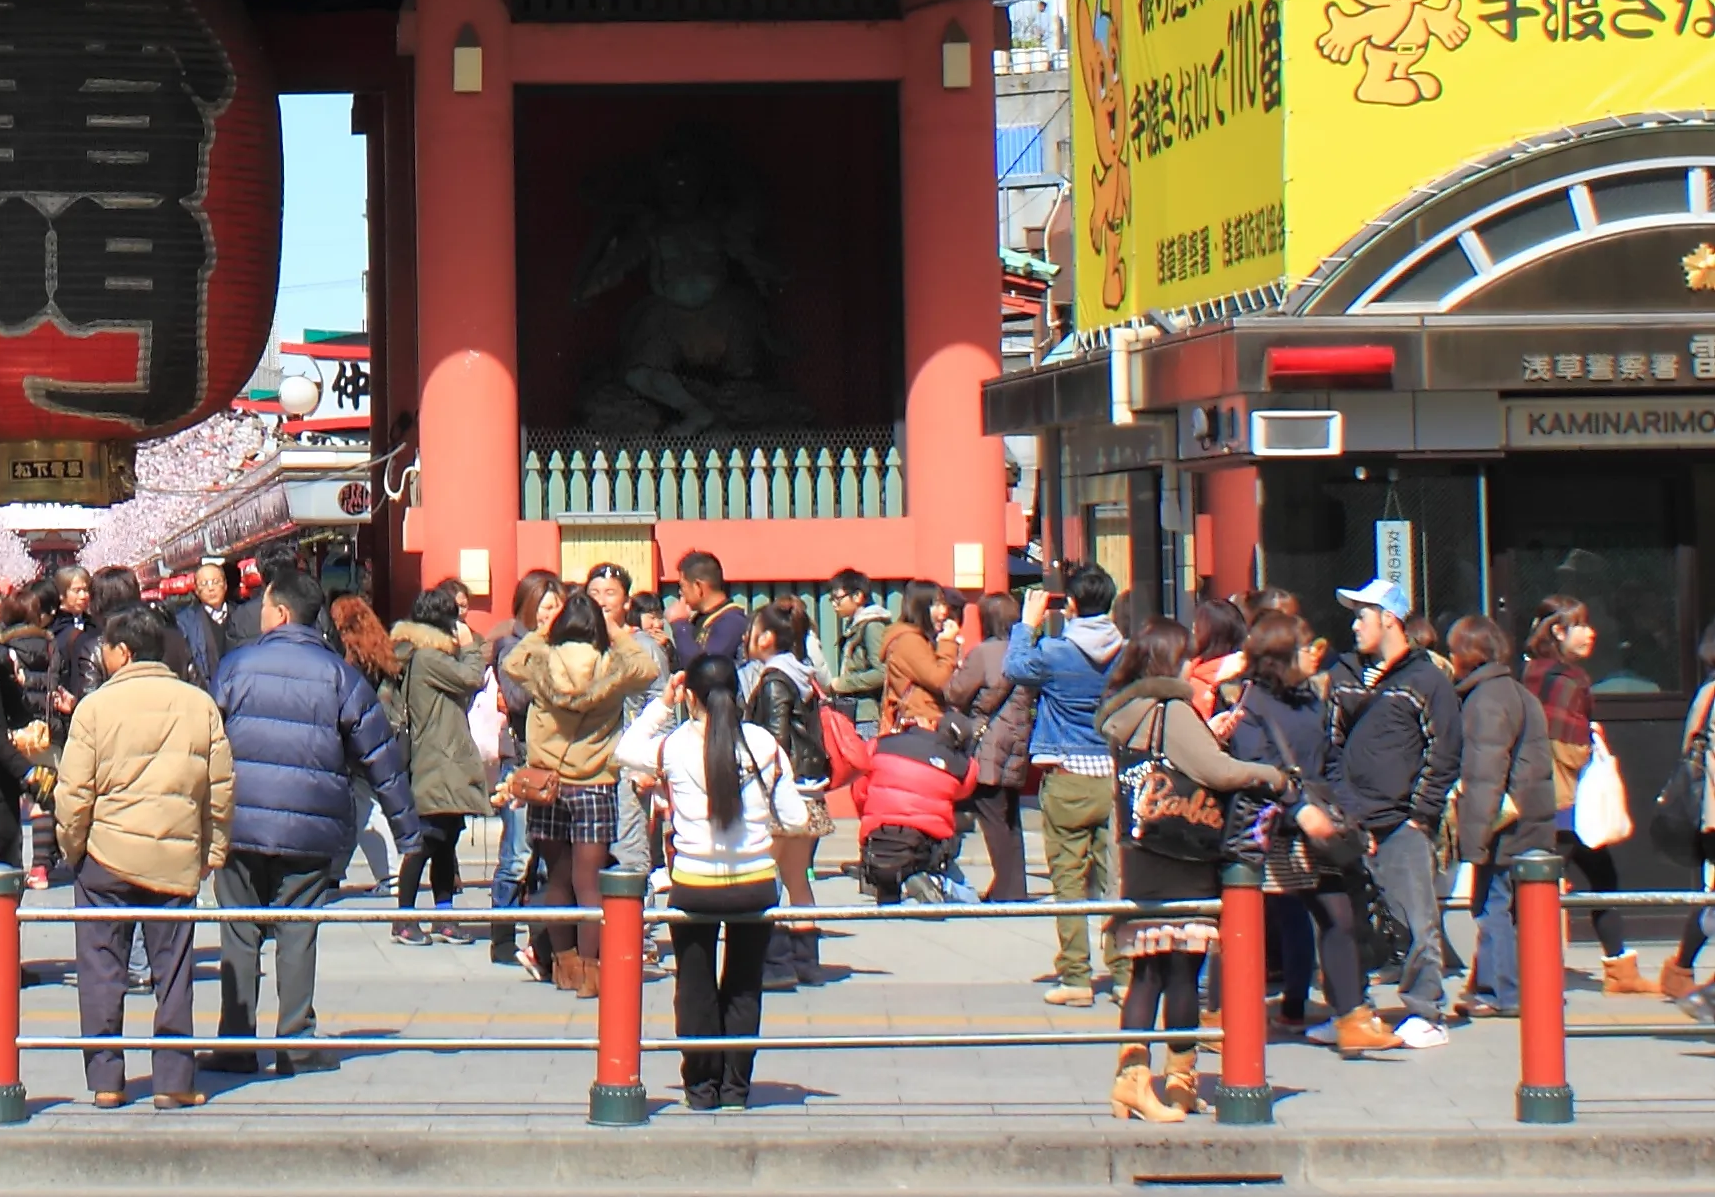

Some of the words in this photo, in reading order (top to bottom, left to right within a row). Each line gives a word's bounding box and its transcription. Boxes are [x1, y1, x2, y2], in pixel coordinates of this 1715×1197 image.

[1522, 353, 1681, 382] 浅草警察署
[1137, 773, 1224, 830] Barbie
